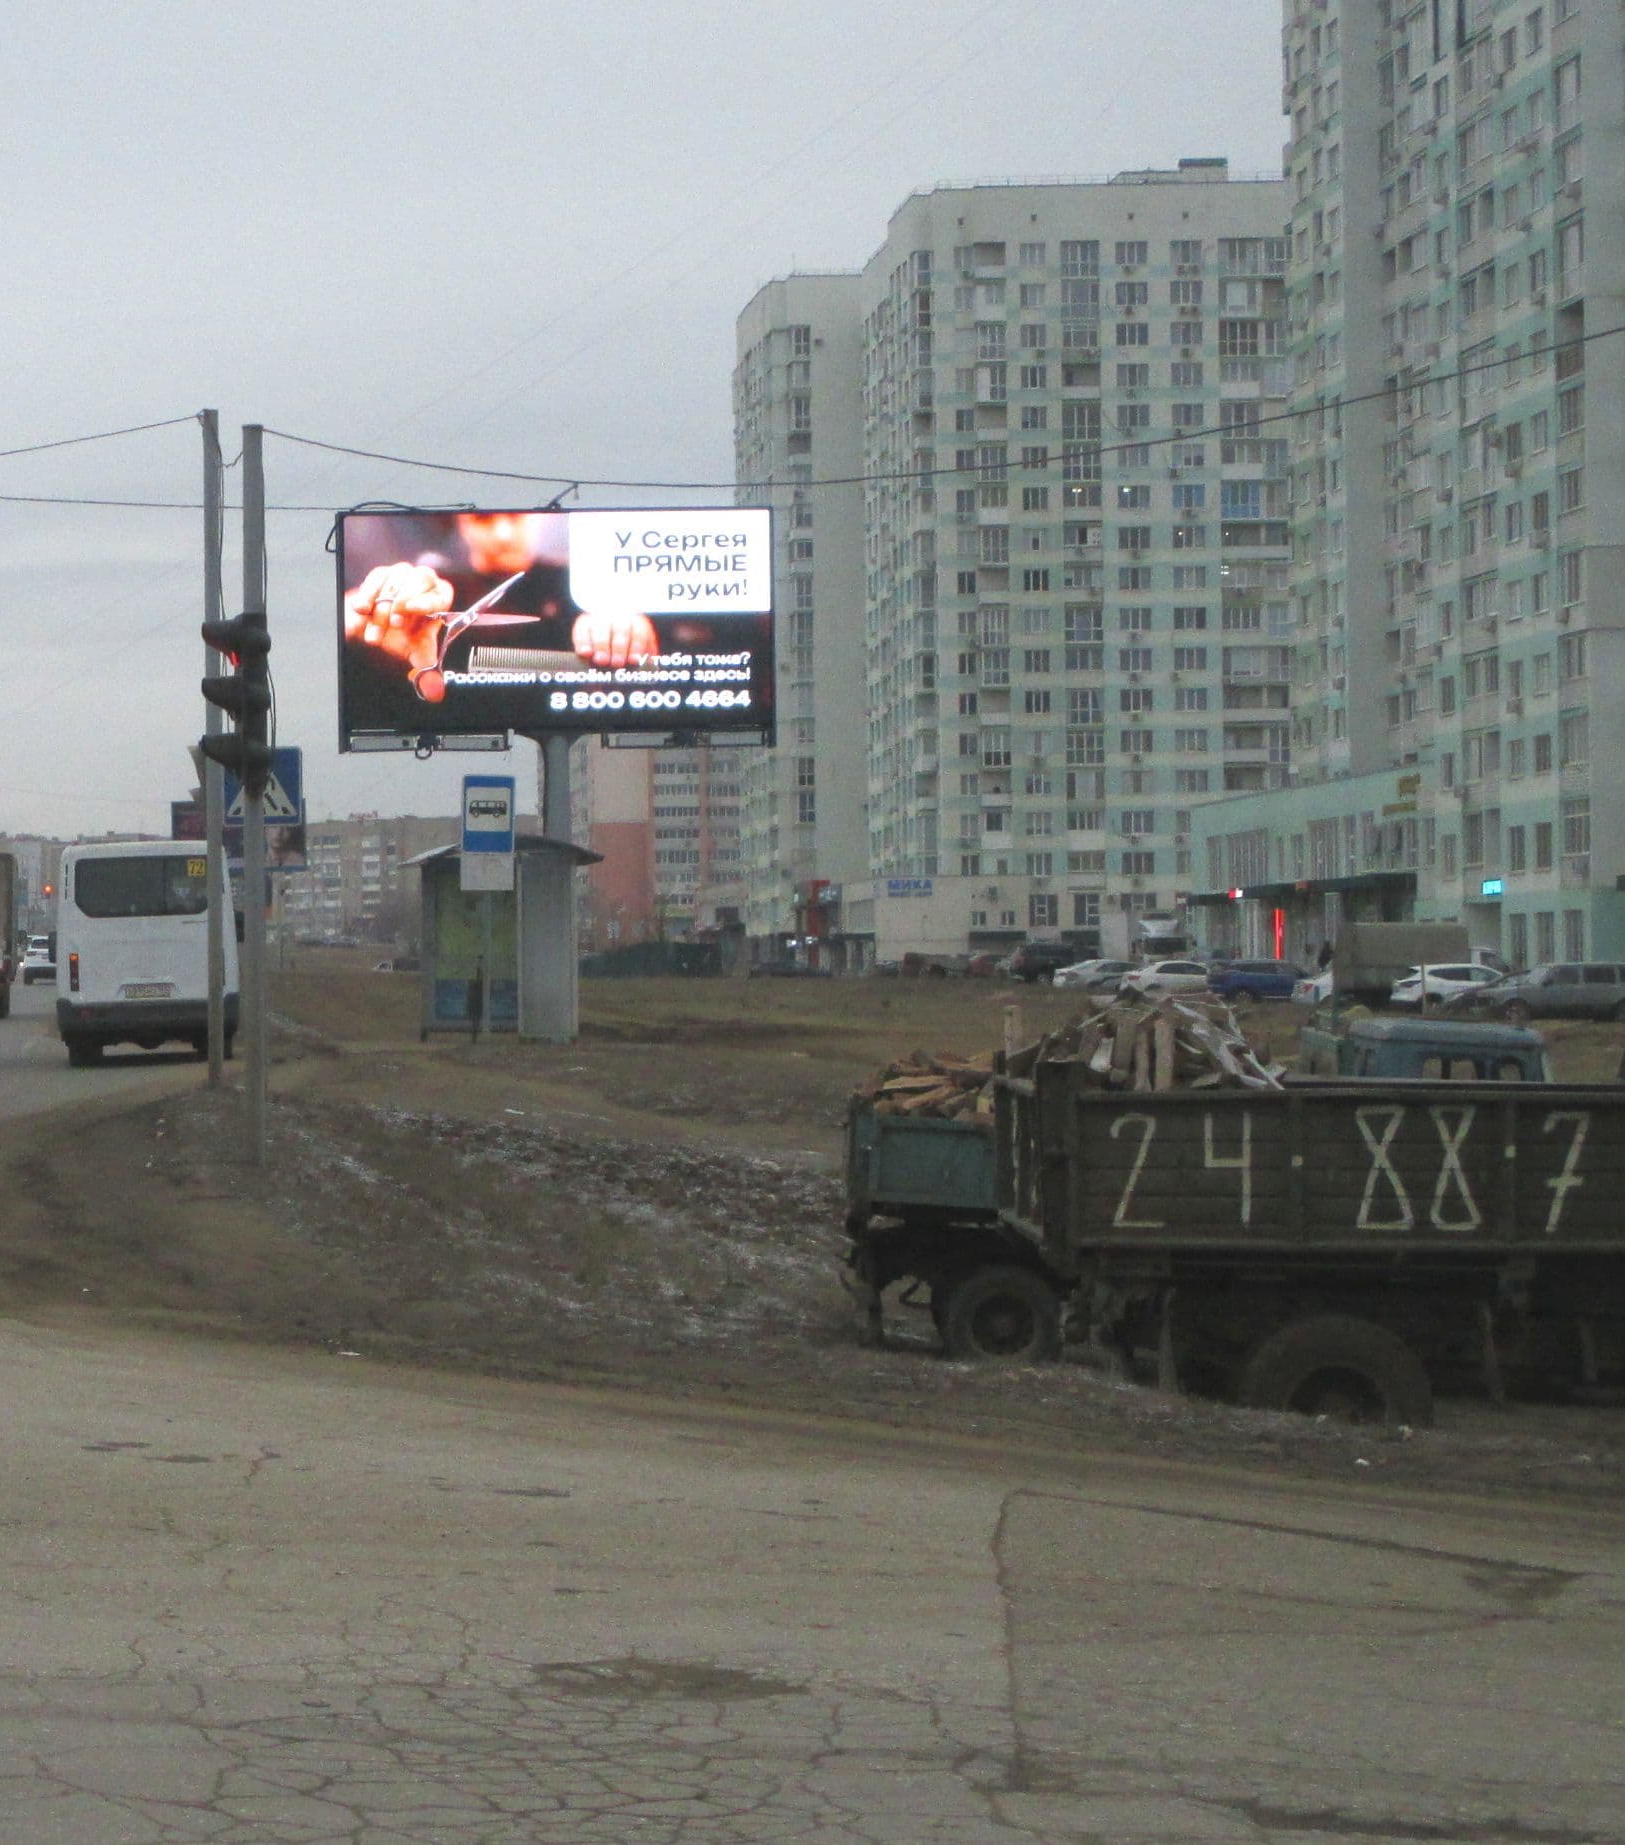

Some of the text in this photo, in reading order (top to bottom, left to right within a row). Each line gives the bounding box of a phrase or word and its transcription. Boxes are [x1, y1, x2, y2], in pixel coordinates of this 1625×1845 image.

[615, 531, 747, 551] У Сергея
[614, 554, 747, 572] ПРЯМЫЕ
[668, 578, 747, 600] руки!
[638, 651, 751, 666] У тебя тоже?
[444, 667, 751, 684] Расскажи о своём бизнесе здесь!
[550, 690, 751, 710] 8 800 600 4664
[189, 860, 204, 874] 72
